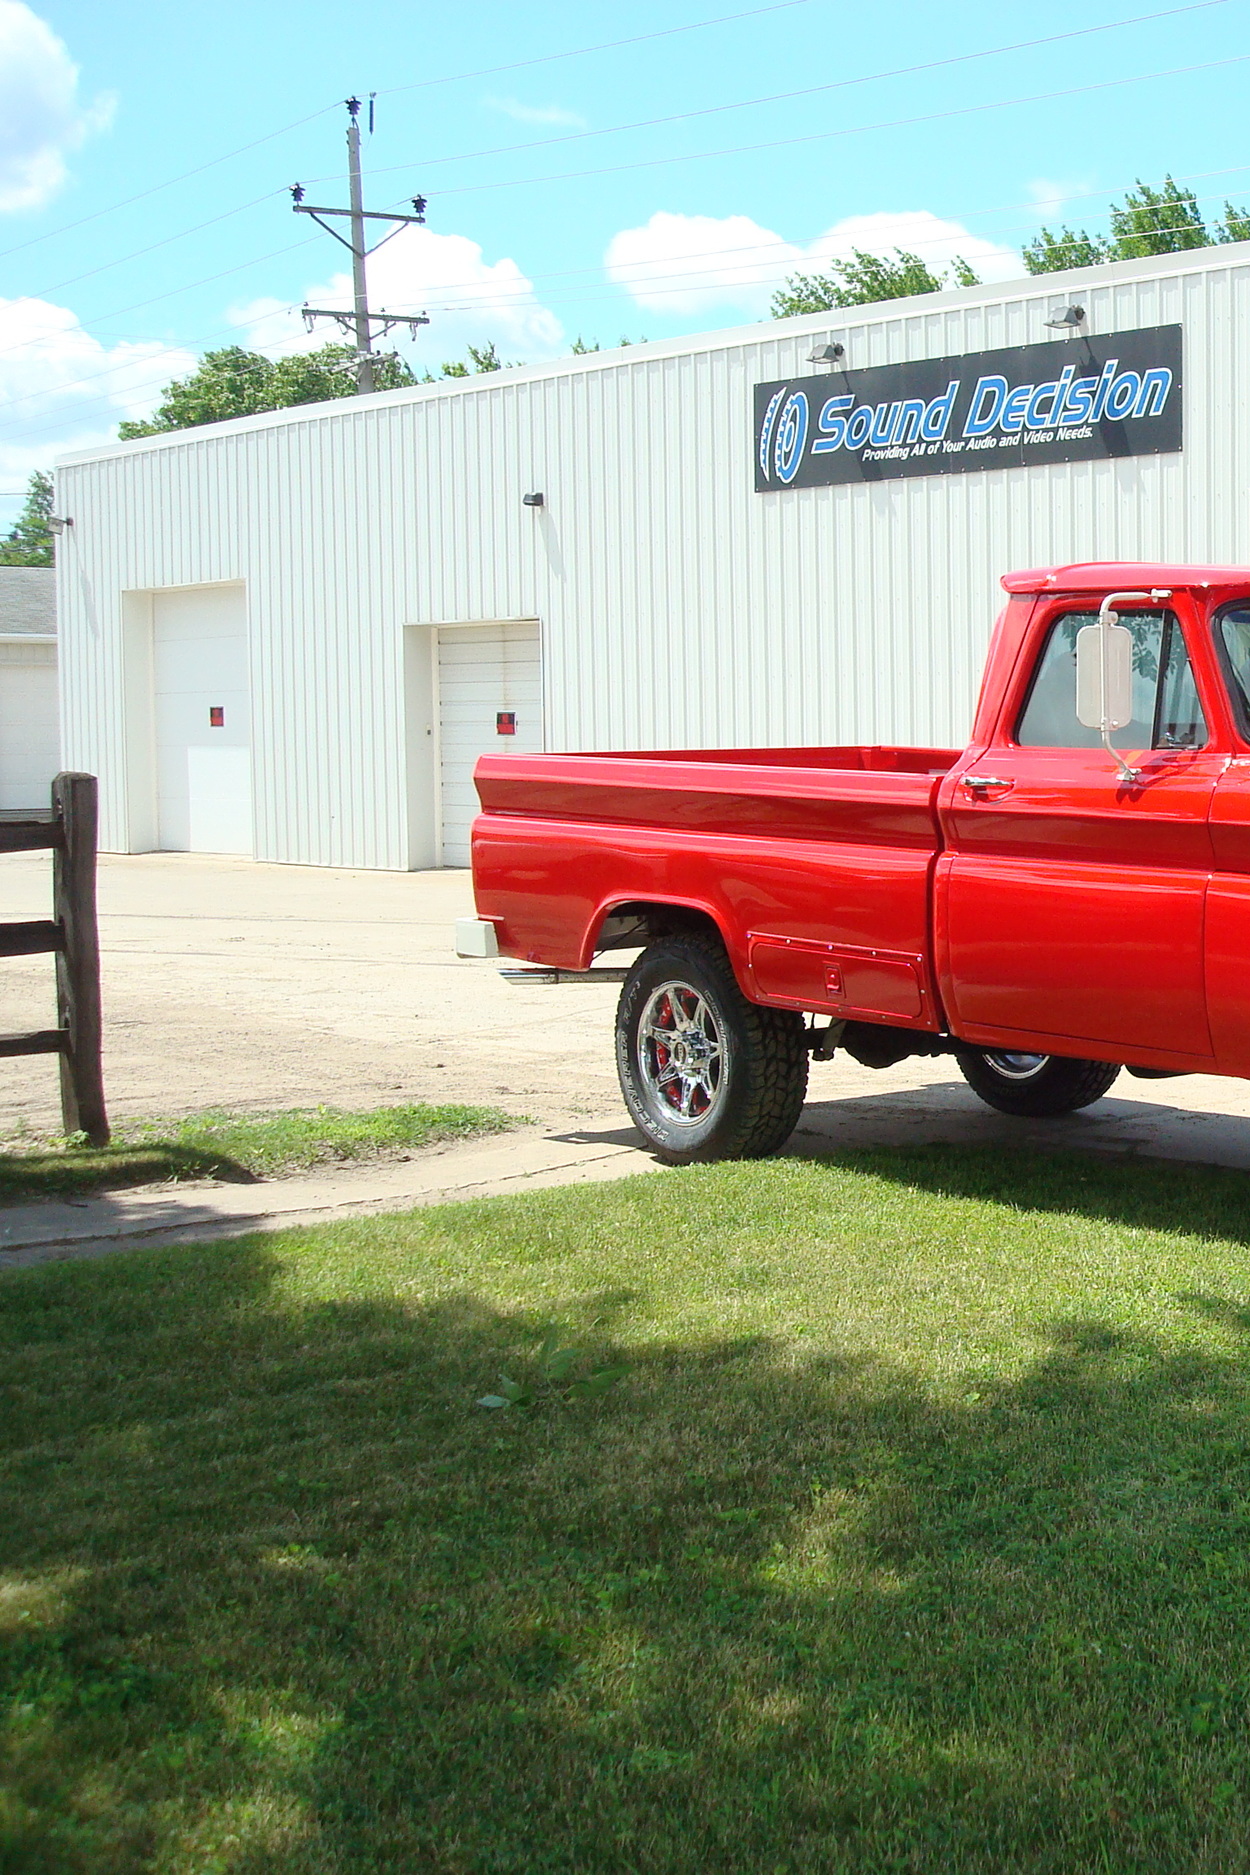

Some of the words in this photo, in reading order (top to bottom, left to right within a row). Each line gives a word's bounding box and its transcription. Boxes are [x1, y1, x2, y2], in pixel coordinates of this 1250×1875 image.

[811, 380, 960, 454] Sound
[963, 358, 1172, 437] Decision
[862, 446, 909, 461] Providing
[910, 443, 926, 457] All
[927, 441, 941, 454] of
[942, 440, 965, 453] Your
[967, 435, 996, 451] Audio
[999, 433, 1020, 447] and
[1023, 429, 1053, 445] Video
